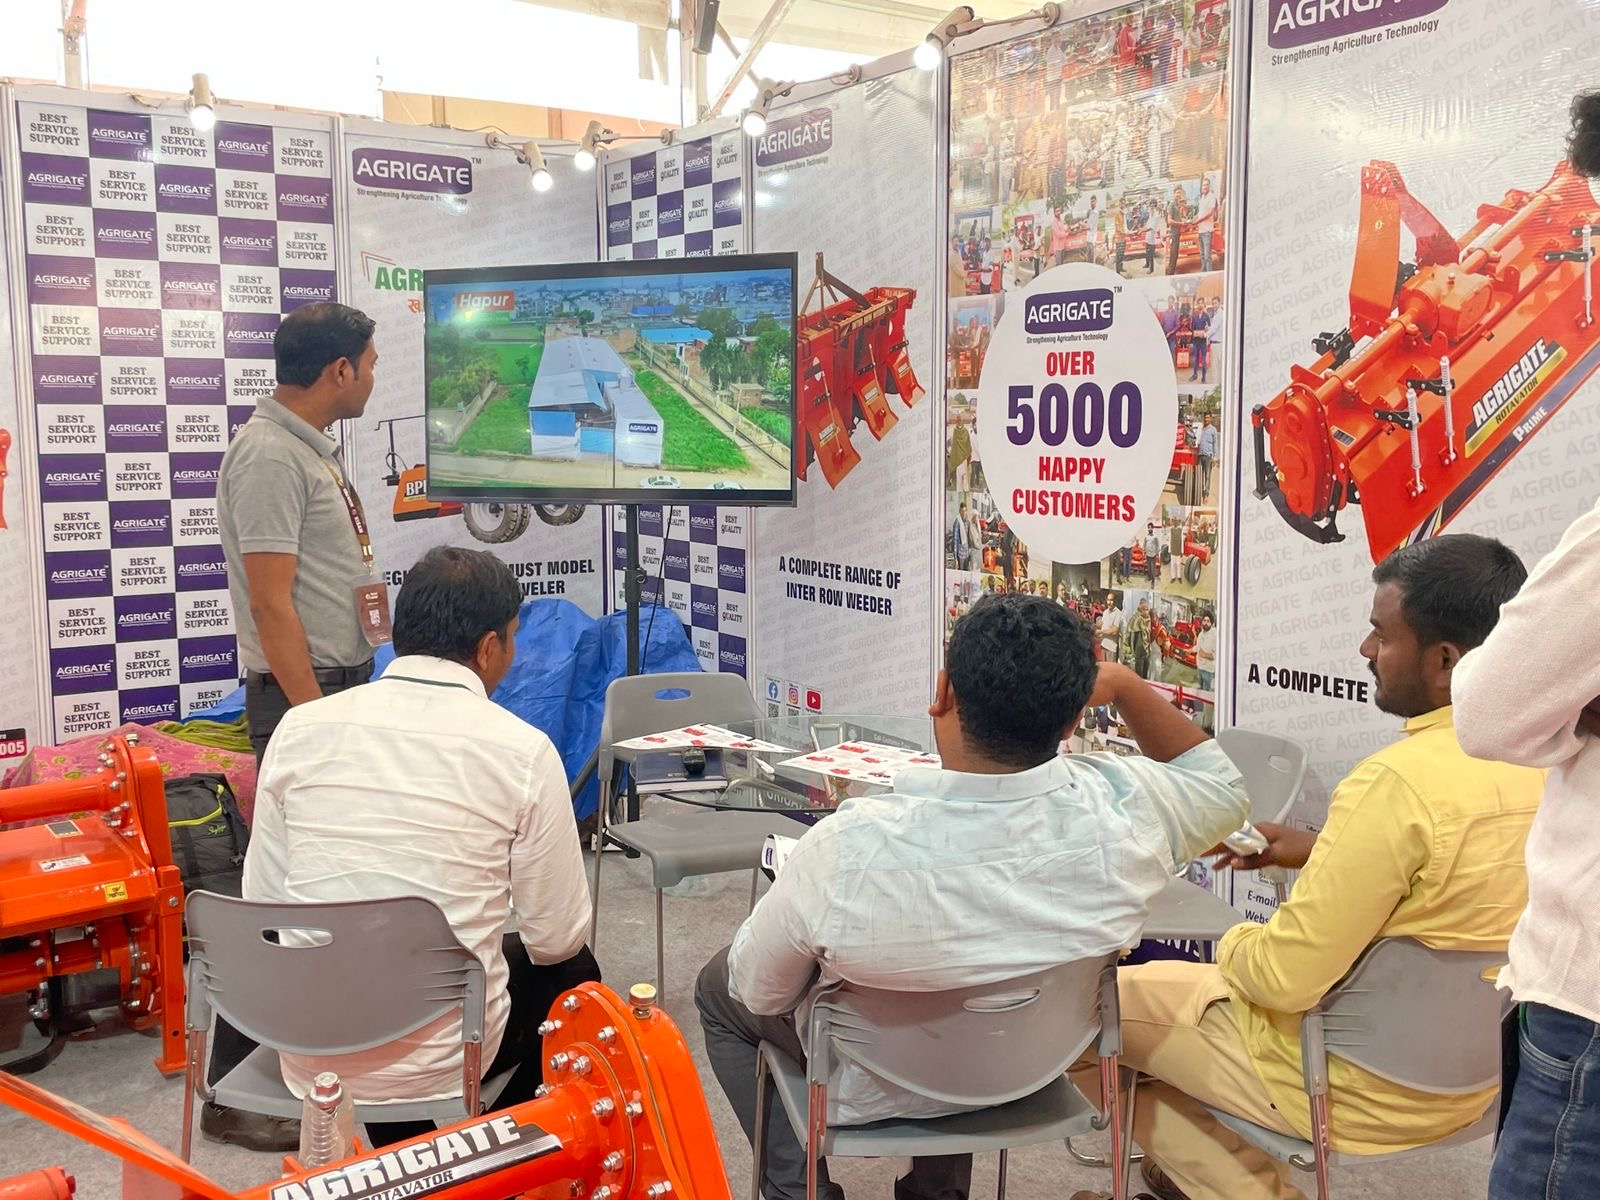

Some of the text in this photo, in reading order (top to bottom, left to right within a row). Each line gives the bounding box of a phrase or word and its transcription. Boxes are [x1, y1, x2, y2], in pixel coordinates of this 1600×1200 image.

[1272, 19, 1439, 66] Strengthening Agriculture Technology
[39, 113, 68, 124] BEST
[30, 122, 78, 136] SERVICE
[91, 127, 147, 140] AGRIGATE
[170, 126, 196, 136] BEST
[29, 133, 80, 146] SUPPORT
[161, 135, 205, 147] SERVICE
[289, 137, 314, 147] BEST
[758, 119, 830, 156] AGRIGATE
[160, 145, 207, 157] SUPPORT
[217, 139, 268, 152] AGRIGATE
[720, 144, 733, 153] BEST
[281, 146, 322, 158] SERVICE
[281, 156, 324, 168] SUPPORT
[664, 159, 675, 168] BEST
[685, 156, 710, 168] AGRIGATE
[716, 154, 738, 168] QUALITY
[108, 169, 136, 180] BEST
[356, 158, 470, 185] AGRIGATE
[614, 172, 624, 180] BEST
[633, 169, 655, 180] AGRIGATE
[660, 168, 679, 181] QUALITY
[27, 172, 85, 185] AGRIGATE
[99, 179, 146, 191] SERVICE
[158, 182, 211, 194] AGRIGATE
[233, 180, 258, 189] BEST
[611, 181, 627, 192] QUALITY
[99, 189, 148, 201] SUPPORT
[225, 189, 267, 200] SERVICE
[278, 192, 327, 203] AGRIGATE
[357, 188, 399, 200] Strengthening
[401, 192, 434, 201] Agriculture
[224, 199, 269, 210] SUPPORT
[692, 199, 704, 208] BEST
[639, 210, 650, 218] BEST
[659, 208, 682, 219] AGRIGATE
[688, 208, 708, 221] QUALITY
[45, 215, 74, 225] BEST
[636, 219, 653, 231] QUALITY
[36, 225, 84, 236] SERVICE
[96, 227, 152, 239] AGRIGATE
[174, 223, 201, 233] BEST
[35, 235, 86, 246] SUPPORT
[166, 233, 210, 244] SERVICE
[221, 235, 272, 246] AGRIGATE
[293, 231, 317, 240] BEST
[165, 243, 212, 253] SUPPORT
[285, 240, 326, 251] SERVICE
[284, 250, 327, 260] SUPPORT
[33, 274, 90, 285] AGRIGATE
[282, 285, 330, 295] AGRIGATE
[460, 294, 509, 310] Hapur
[1027, 300, 1111, 324] AGRIGATE
[51, 316, 79, 324] BEST
[42, 325, 89, 335] SERVICE
[226, 330, 275, 339] AGRIGATE
[41, 336, 91, 345] SUPPORT
[1026, 332, 1108, 344] Strengthening Agriculture Technology
[1046, 350, 1095, 376] OVER
[119, 366, 146, 375] BEST
[241, 368, 266, 376] BEST
[39, 374, 95, 383] AGRIGATE
[110, 376, 156, 385] SERVICE
[167, 376, 220, 384] AGRIGATE
[233, 378, 275, 386] SERVICE
[1472, 338, 1548, 428] AGRIGATE
[109, 386, 157, 395] SUPPORT
[1495, 377, 1538, 424] ROTAVATOR
[57, 415, 85, 423] BEST
[1006, 380, 1142, 448] 5000
[48, 425, 95, 433] SERVICE
[107, 423, 161, 431] AGRIGATE
[175, 424, 219, 433] SERVICE
[47, 435, 97, 443] SUPPORT
[174, 434, 220, 442] SUPPORT
[124, 462, 151, 470] BEST
[1038, 456, 1105, 484] HAPPY
[45, 472, 101, 481] AGRIGATE
[115, 472, 160, 481] SERVICE
[172, 470, 219, 478] AGRIGAT
[115, 482, 162, 491] SUPPORT
[1012, 488, 1135, 522] CUSTOMERS
[62, 512, 90, 520] BEST
[188, 508, 214, 516] BEST
[112, 518, 166, 527] AGRIGATE
[180, 517, 217, 526] SERVIC
[691, 516, 714, 526] AGRIGATE
[725, 515, 738, 524] BEST
[53, 521, 100, 531] SERVICE
[179, 526, 219, 536] SUPPOR
[720, 524, 742, 534] QUALITY
[52, 531, 102, 541] SUPPORT
[129, 557, 156, 565] BEST
[177, 561, 227, 572] AGRIGATE
[120, 566, 165, 576] SERVICE
[548, 559, 594, 575] MODEL
[720, 564, 744, 574] AGRIGATE
[50, 568, 106, 578] AGRIGATE
[779, 556, 900, 590] A COMPLETE RANGE OF
[120, 575, 167, 586] SUPPORT
[193, 599, 218, 608] BEST
[786, 582, 892, 616] INTER ROW WEEDER
[68, 607, 95, 617] BEST
[692, 602, 716, 612] AGRIGATE
[726, 603, 738, 612] BEST
[117, 611, 171, 622] AGRIGATE
[184, 608, 227, 619] SERVICE
[722, 612, 742, 623] QUALITY
[59, 616, 105, 628] SERVICE
[184, 617, 229, 628] SUPPORT
[58, 626, 107, 637] SUPPORT
[134, 650, 160, 659] BEST
[181, 652, 232, 664] AGRIGATE
[720, 650, 744, 662] AGRIGATE
[56, 662, 111, 674] AGRIGATE
[126, 658, 170, 670] SERVICE
[125, 668, 171, 680] SUPPORT
[1248, 664, 1368, 703] A COMPLETE
[197, 690, 222, 700] BEST
[73, 701, 101, 712] BEST
[122, 703, 175, 715] AGRIGATE
[65, 710, 110, 723] SERVICE
[64, 720, 112, 732] SUPPORT
[274, 1116, 521, 1200] AGRIGATE
